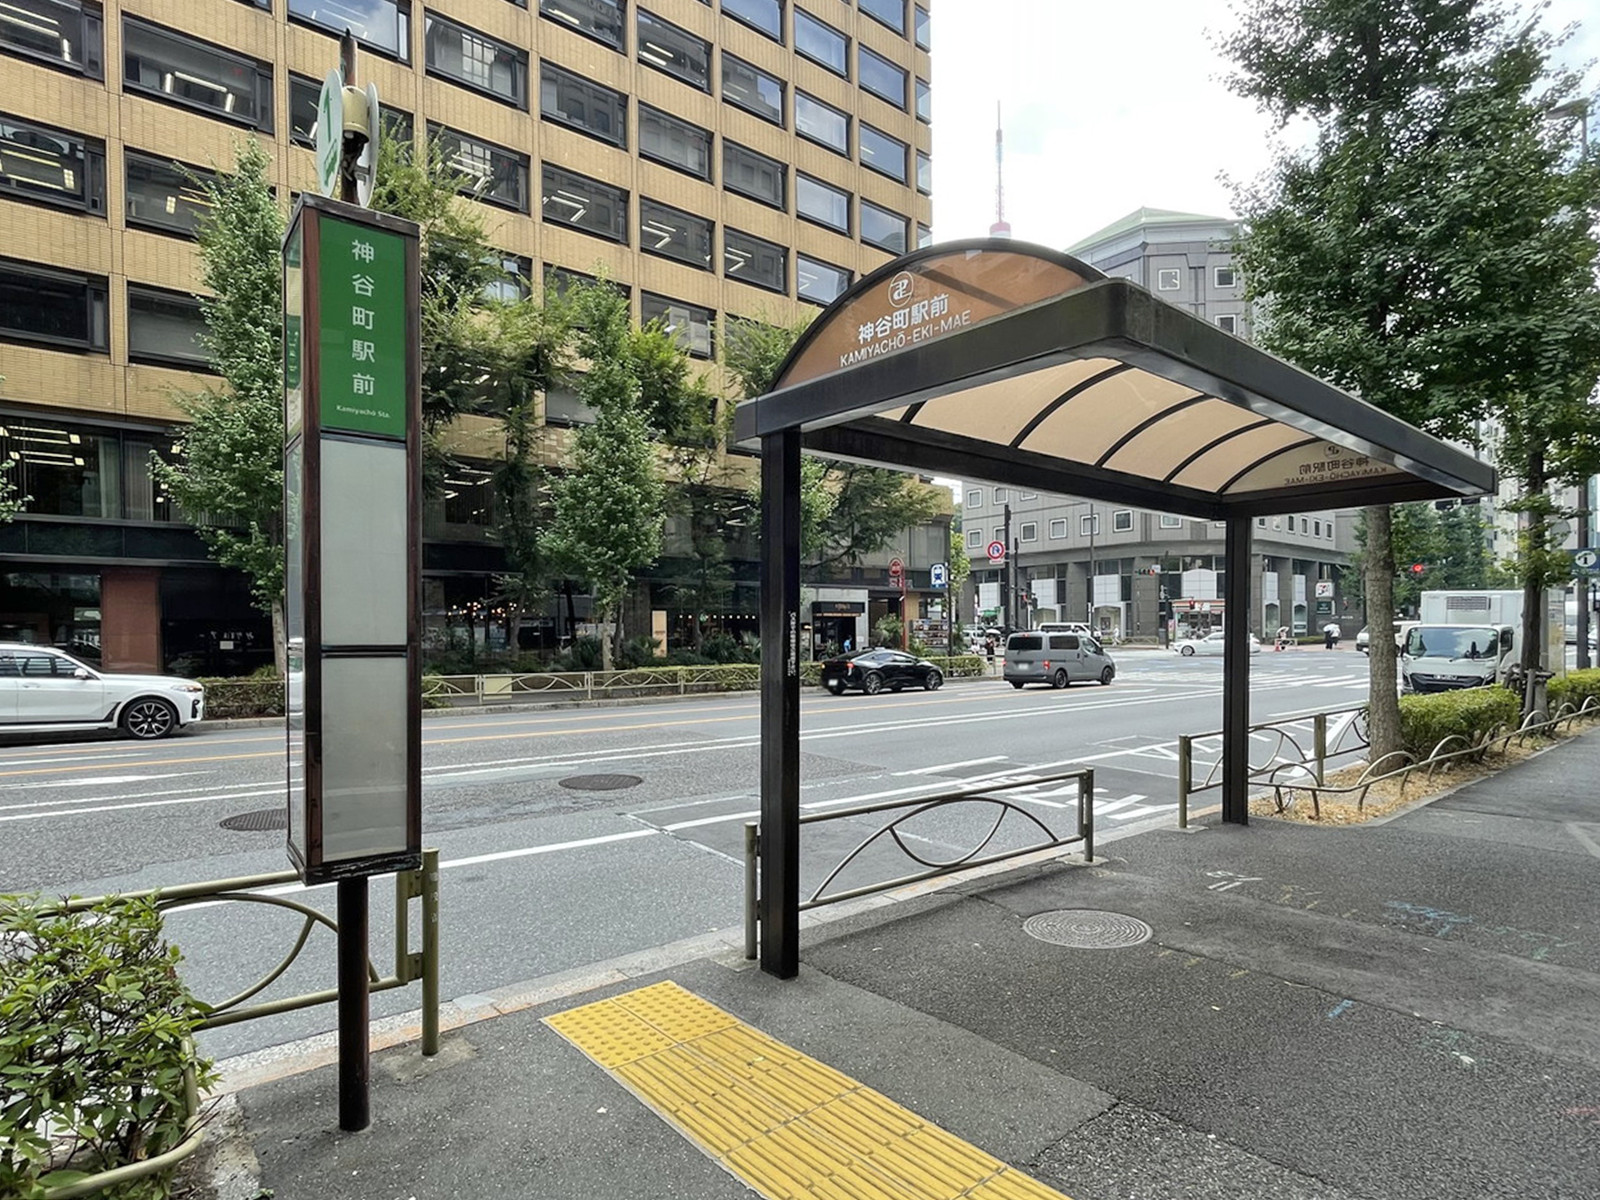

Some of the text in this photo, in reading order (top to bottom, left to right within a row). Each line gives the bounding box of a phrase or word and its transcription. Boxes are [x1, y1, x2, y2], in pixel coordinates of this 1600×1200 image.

[351, 239, 376, 396] 神谷町駅前
[857, 293, 949, 344] 神谷町駅前
